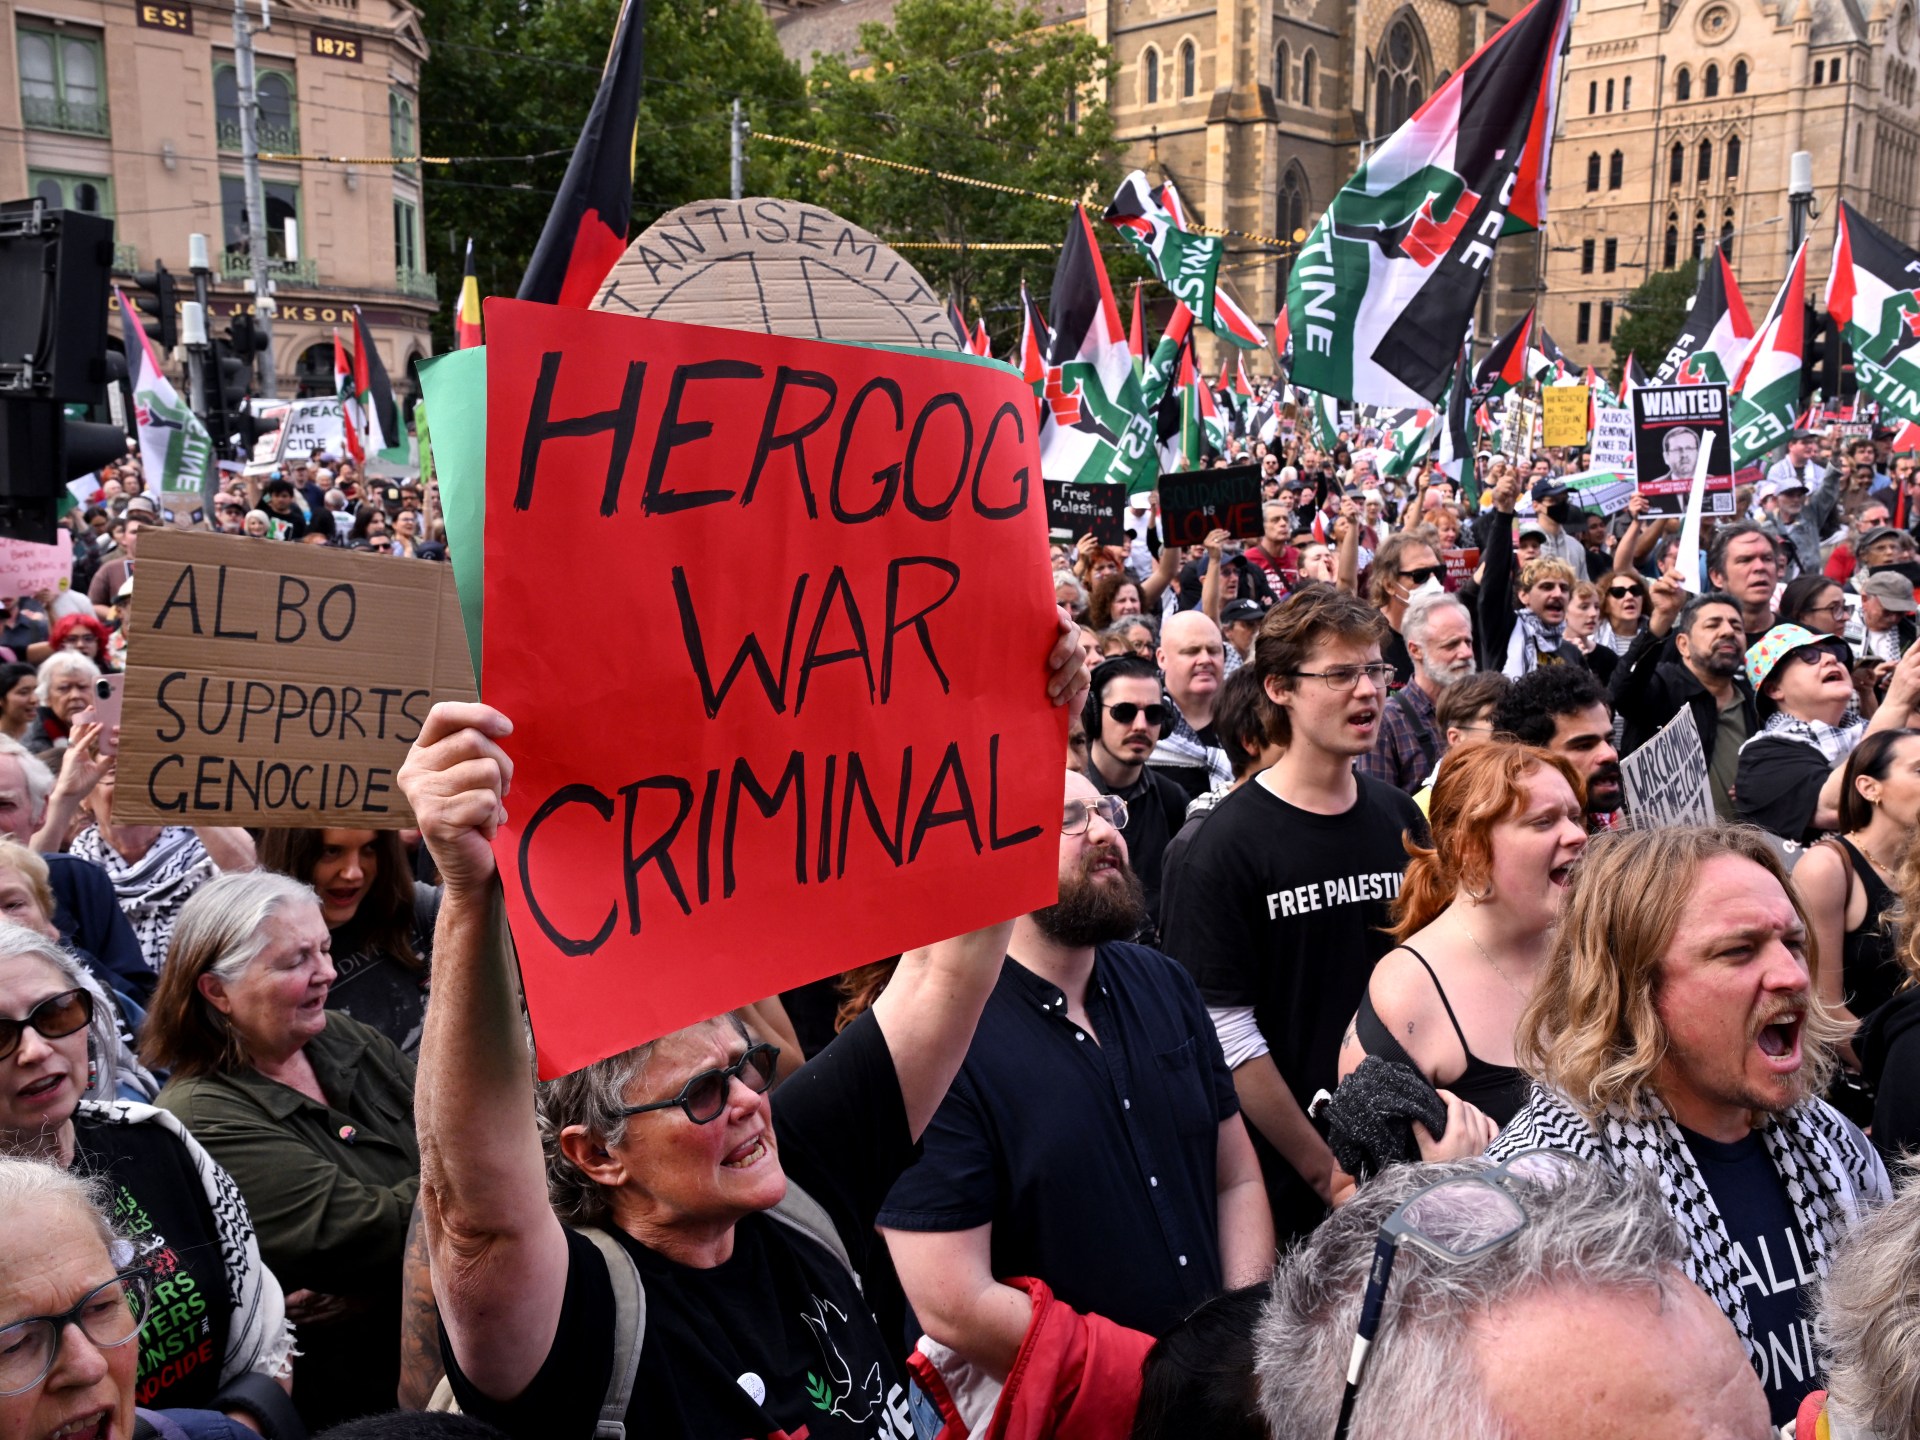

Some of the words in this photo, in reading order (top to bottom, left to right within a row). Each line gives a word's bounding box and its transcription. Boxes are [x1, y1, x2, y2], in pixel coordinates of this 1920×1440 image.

[316, 37, 356, 58] 1875
[229, 303, 355, 322] JKSON
[1641, 389, 1723, 417] WANTED
[513, 351, 1029, 524] HERGOG
[1053, 499, 1114, 518] Palestine
[1061, 484, 1091, 501] Free
[672, 556, 961, 719] WAR
[156, 671, 431, 743] SUPPORTS
[147, 754, 393, 813] GENOCIDE
[518, 734, 1045, 957] CRIMINAL
[1266, 883, 1322, 920] FREE
[201, 1315, 210, 1335] THE
